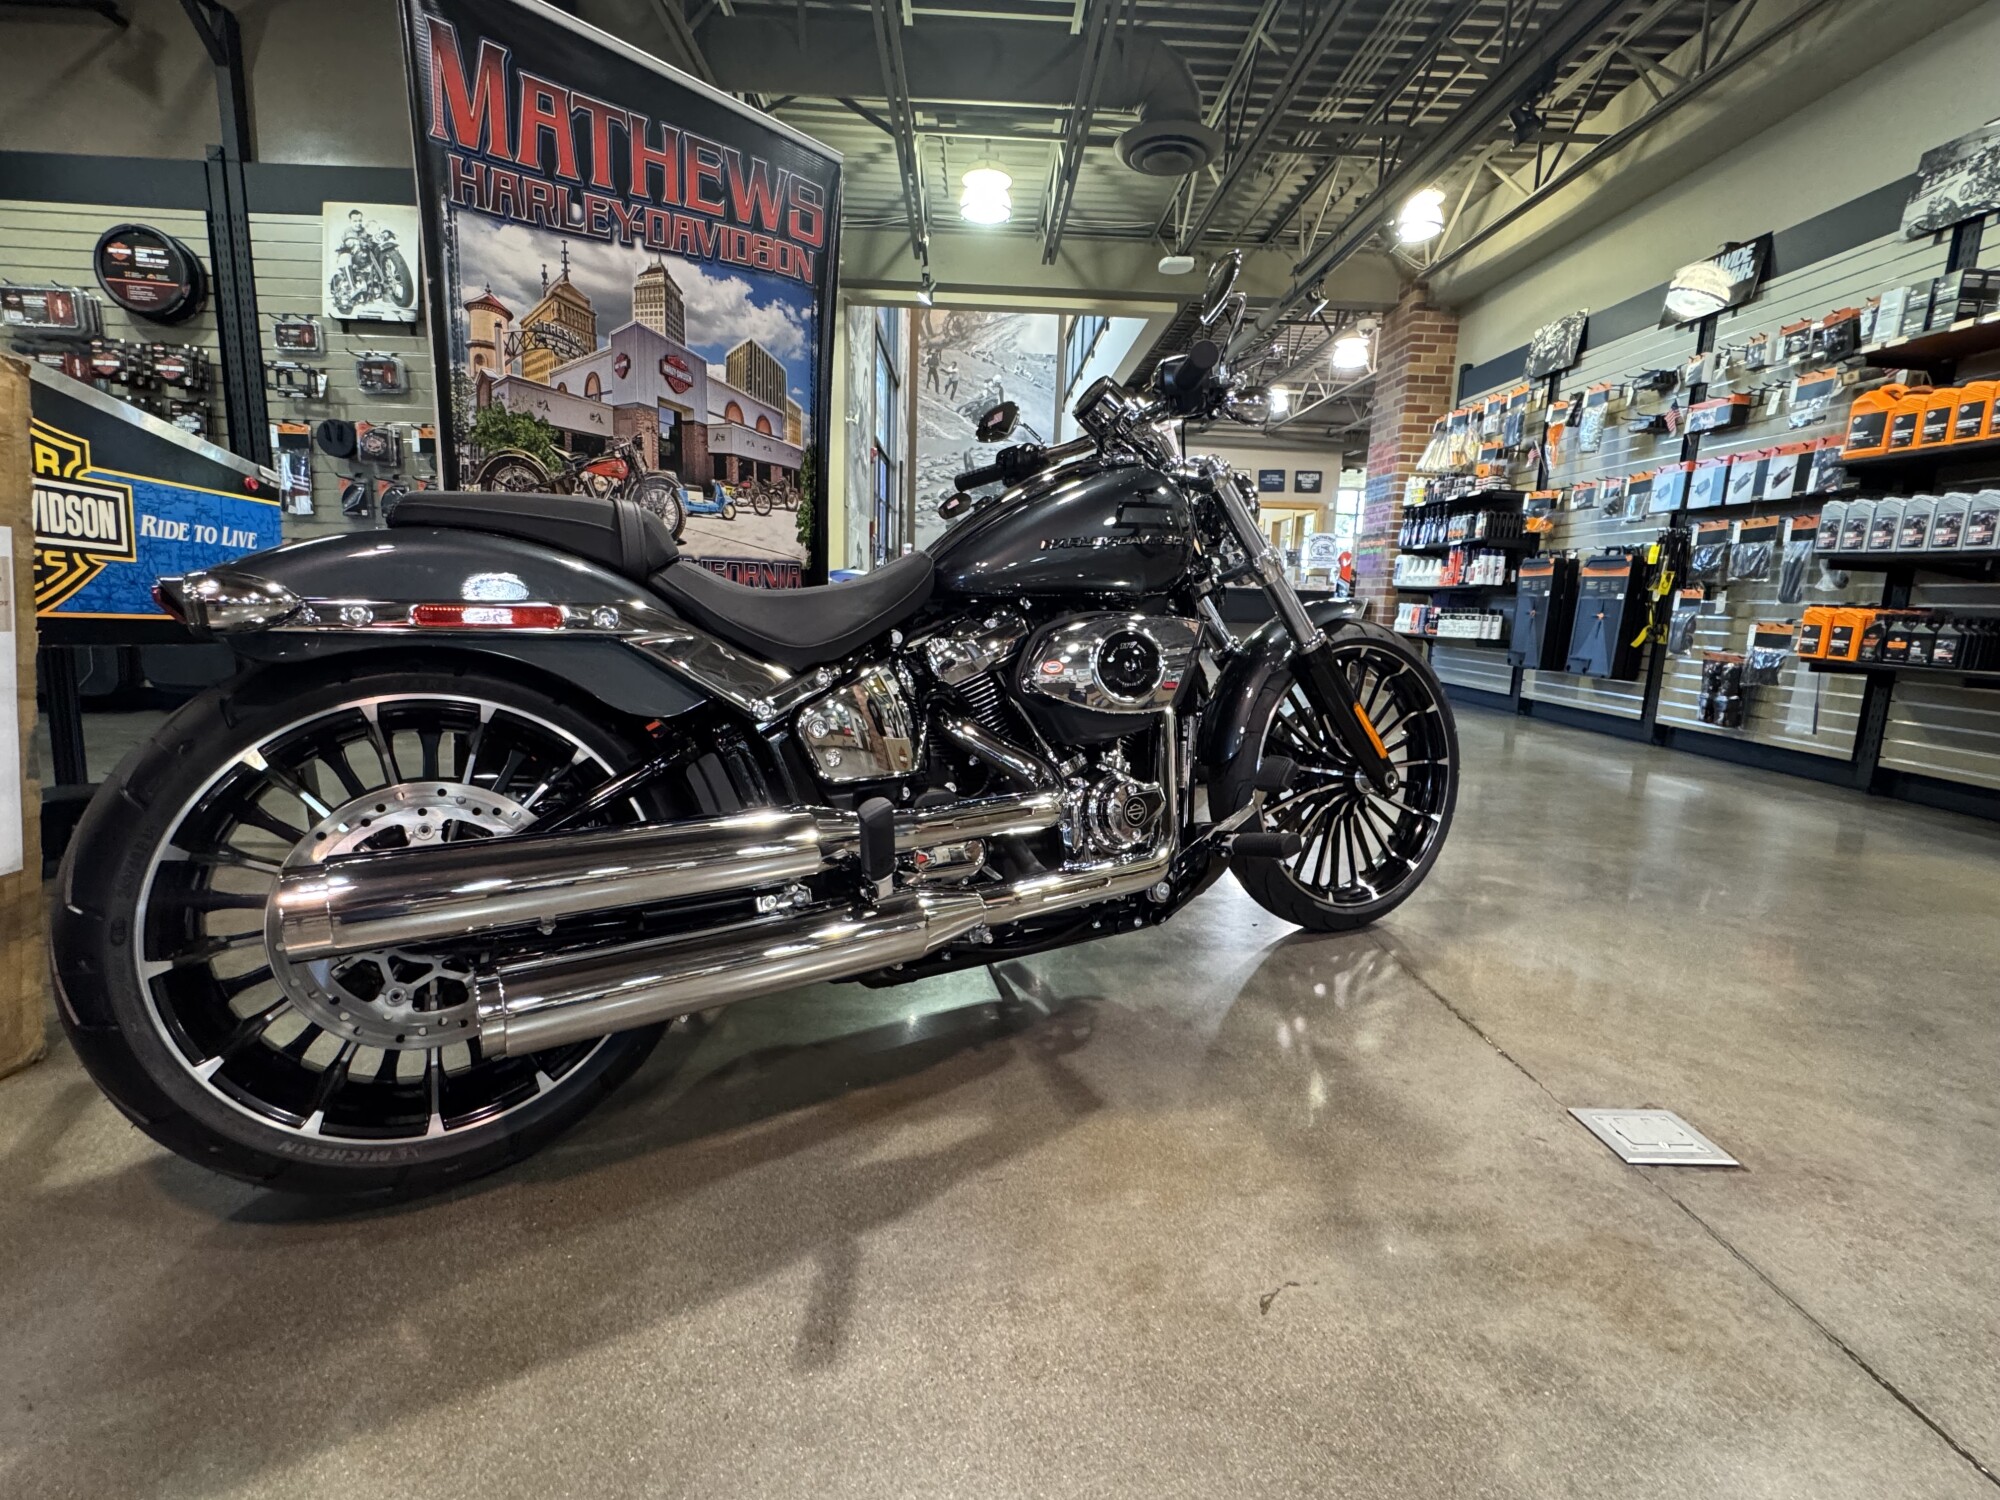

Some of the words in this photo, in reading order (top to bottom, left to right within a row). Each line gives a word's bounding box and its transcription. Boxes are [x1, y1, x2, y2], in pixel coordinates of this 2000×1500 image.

[423, 13, 825, 249] MATHEWS
[447, 153, 815, 284] HARLEY-DAVIDSON
[1720, 242, 1757, 271] WIDE
[543, 321, 582, 346] FRESNO
[140, 514, 190, 541] RIDE
[194, 525, 218, 545] TO
[221, 526, 258, 550] LIVE
[277, 1140, 391, 1163] MICHELIN
